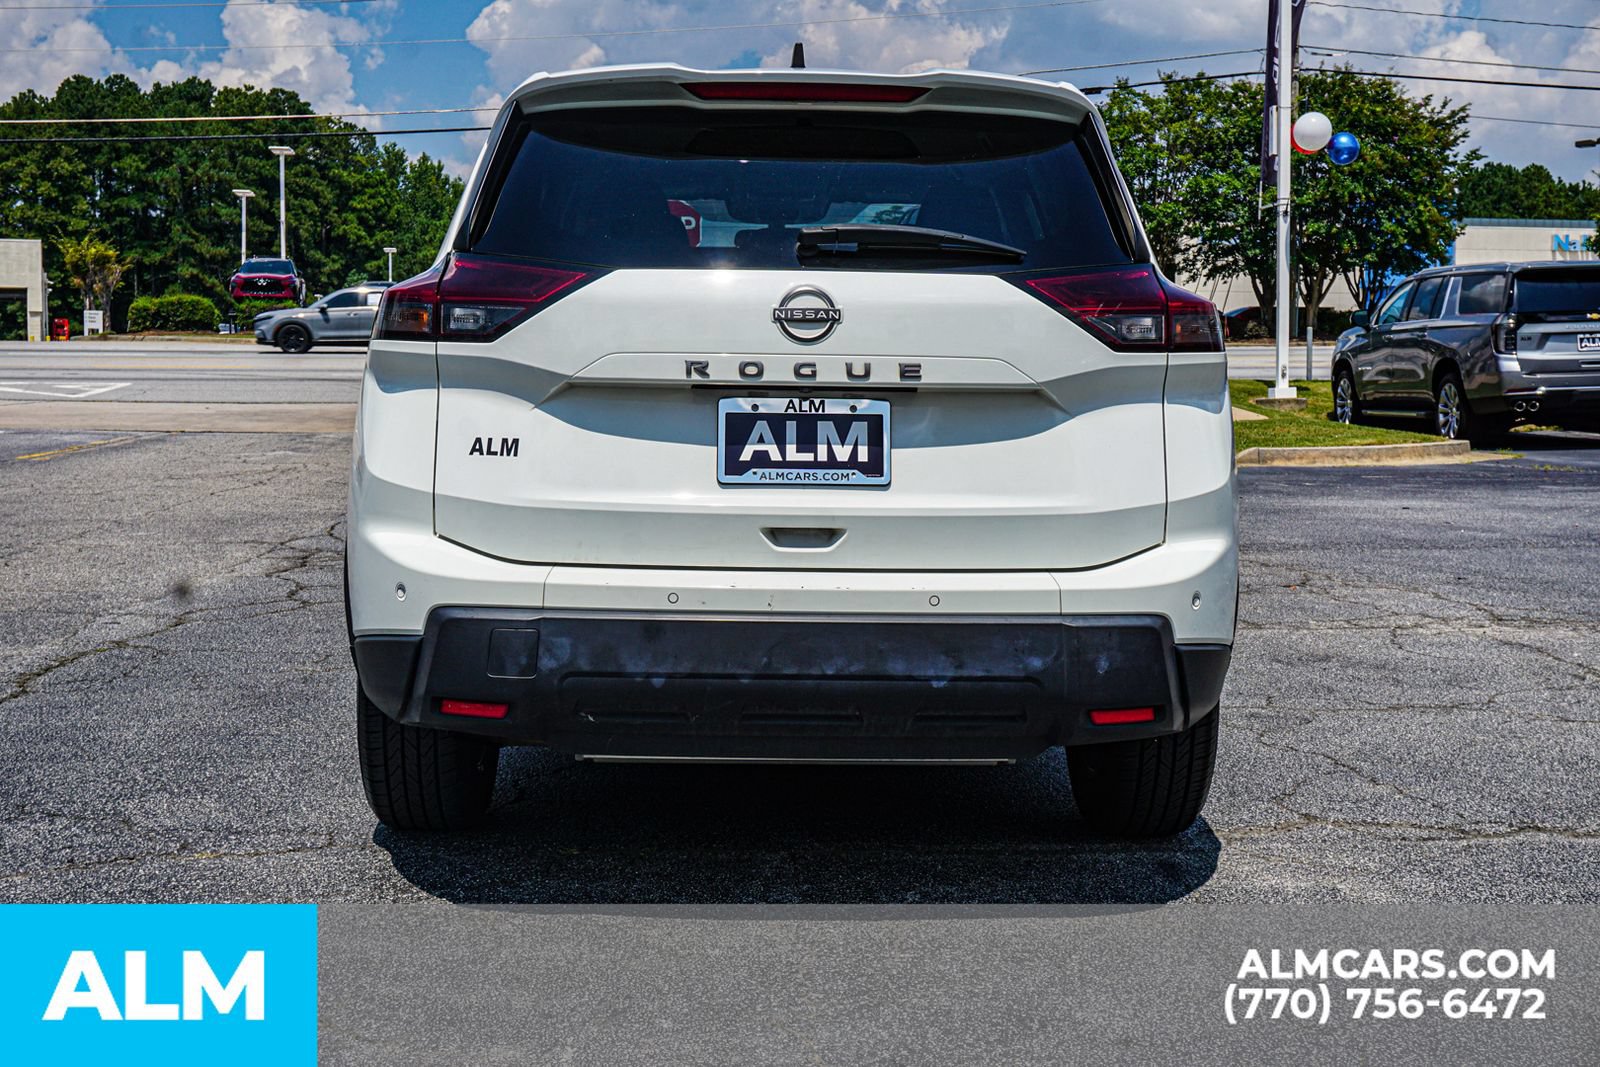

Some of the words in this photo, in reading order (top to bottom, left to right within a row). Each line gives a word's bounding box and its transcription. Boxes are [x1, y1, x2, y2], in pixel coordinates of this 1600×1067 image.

[774, 309, 840, 320] NISSAN
[685, 360, 922, 381] ROGUE
[784, 399, 826, 413] ALM
[469, 437, 520, 457] ALM
[739, 420, 869, 463] ALM
[759, 471, 850, 482] ALMCARS.COM
